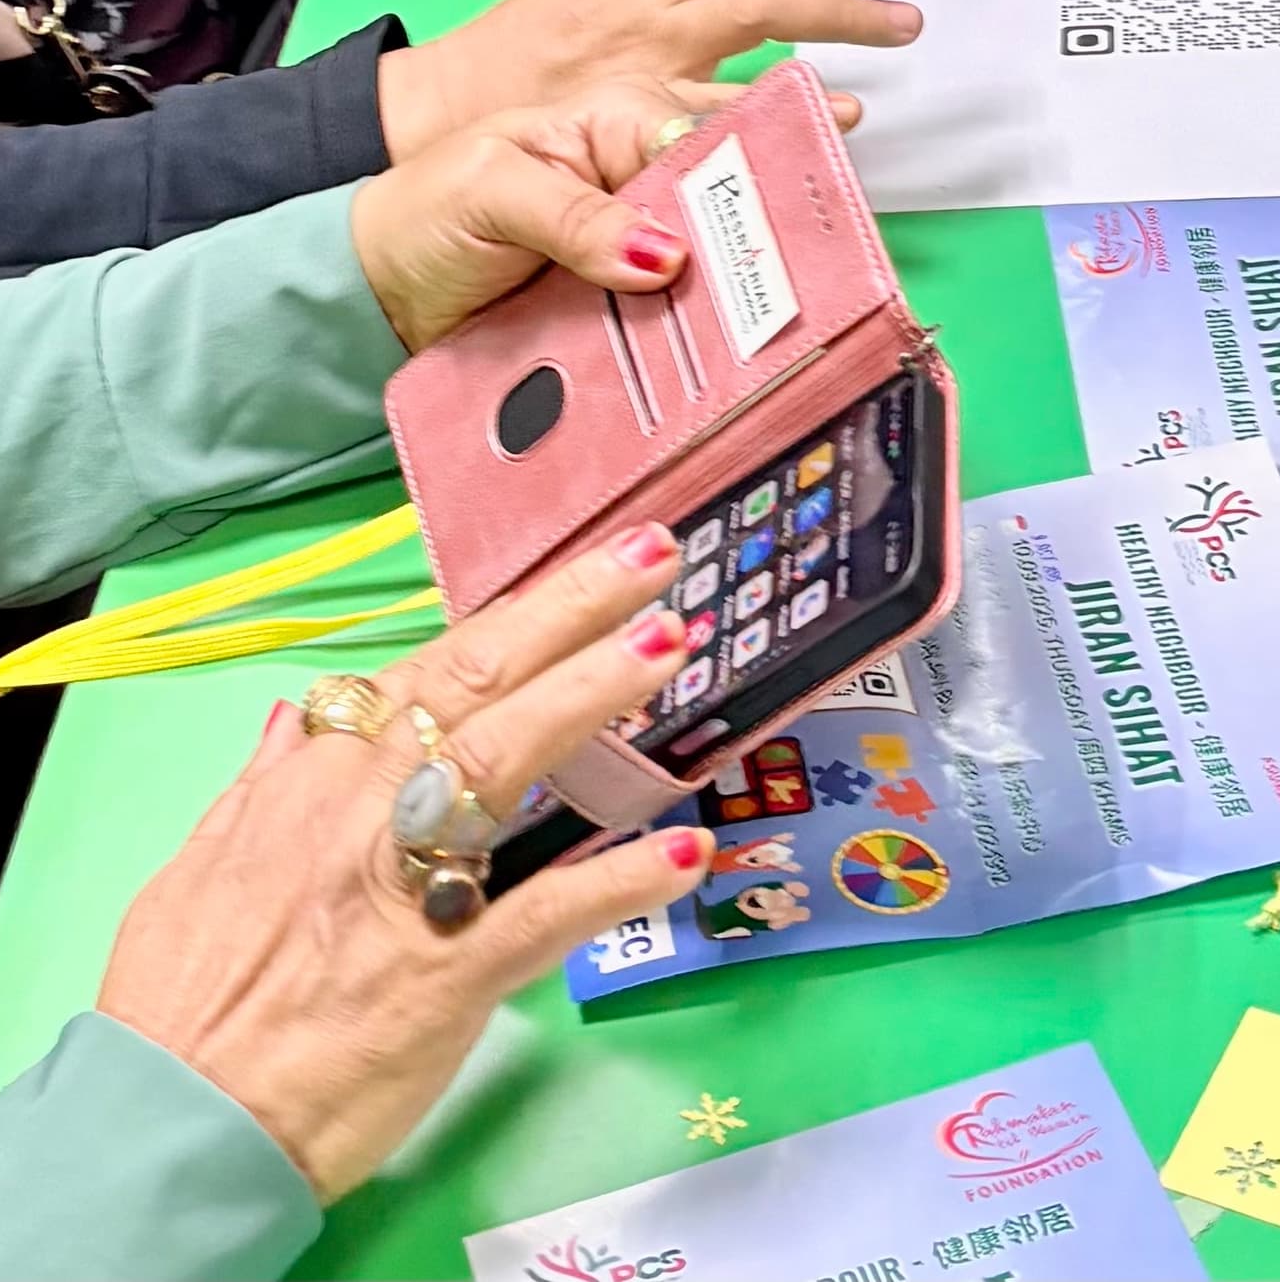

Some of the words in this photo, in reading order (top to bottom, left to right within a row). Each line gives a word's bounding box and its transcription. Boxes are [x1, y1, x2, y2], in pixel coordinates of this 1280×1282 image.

[1204, 309, 1252, 392] NEIGHBOUR
[1225, 400, 1262, 440] LTHY
[1198, 534, 1236, 584] PCS
[1064, 580, 1143, 676] JIRAN
[1114, 524, 1167, 598] HEALTHY
[1144, 604, 1209, 716] NEIGHBOUR
[1191, 735, 1253, 819] 健康邻居
[1045, 635, 1093, 730] THURSDAY
[1091, 779, 1132, 846] KHAMIS
[1101, 682, 1184, 786] SIHAT
[617, 916, 654, 959] EC
[964, 1149, 1104, 1202] FOUNDATION
[933, 1203, 1075, 1270] 健康邻居
